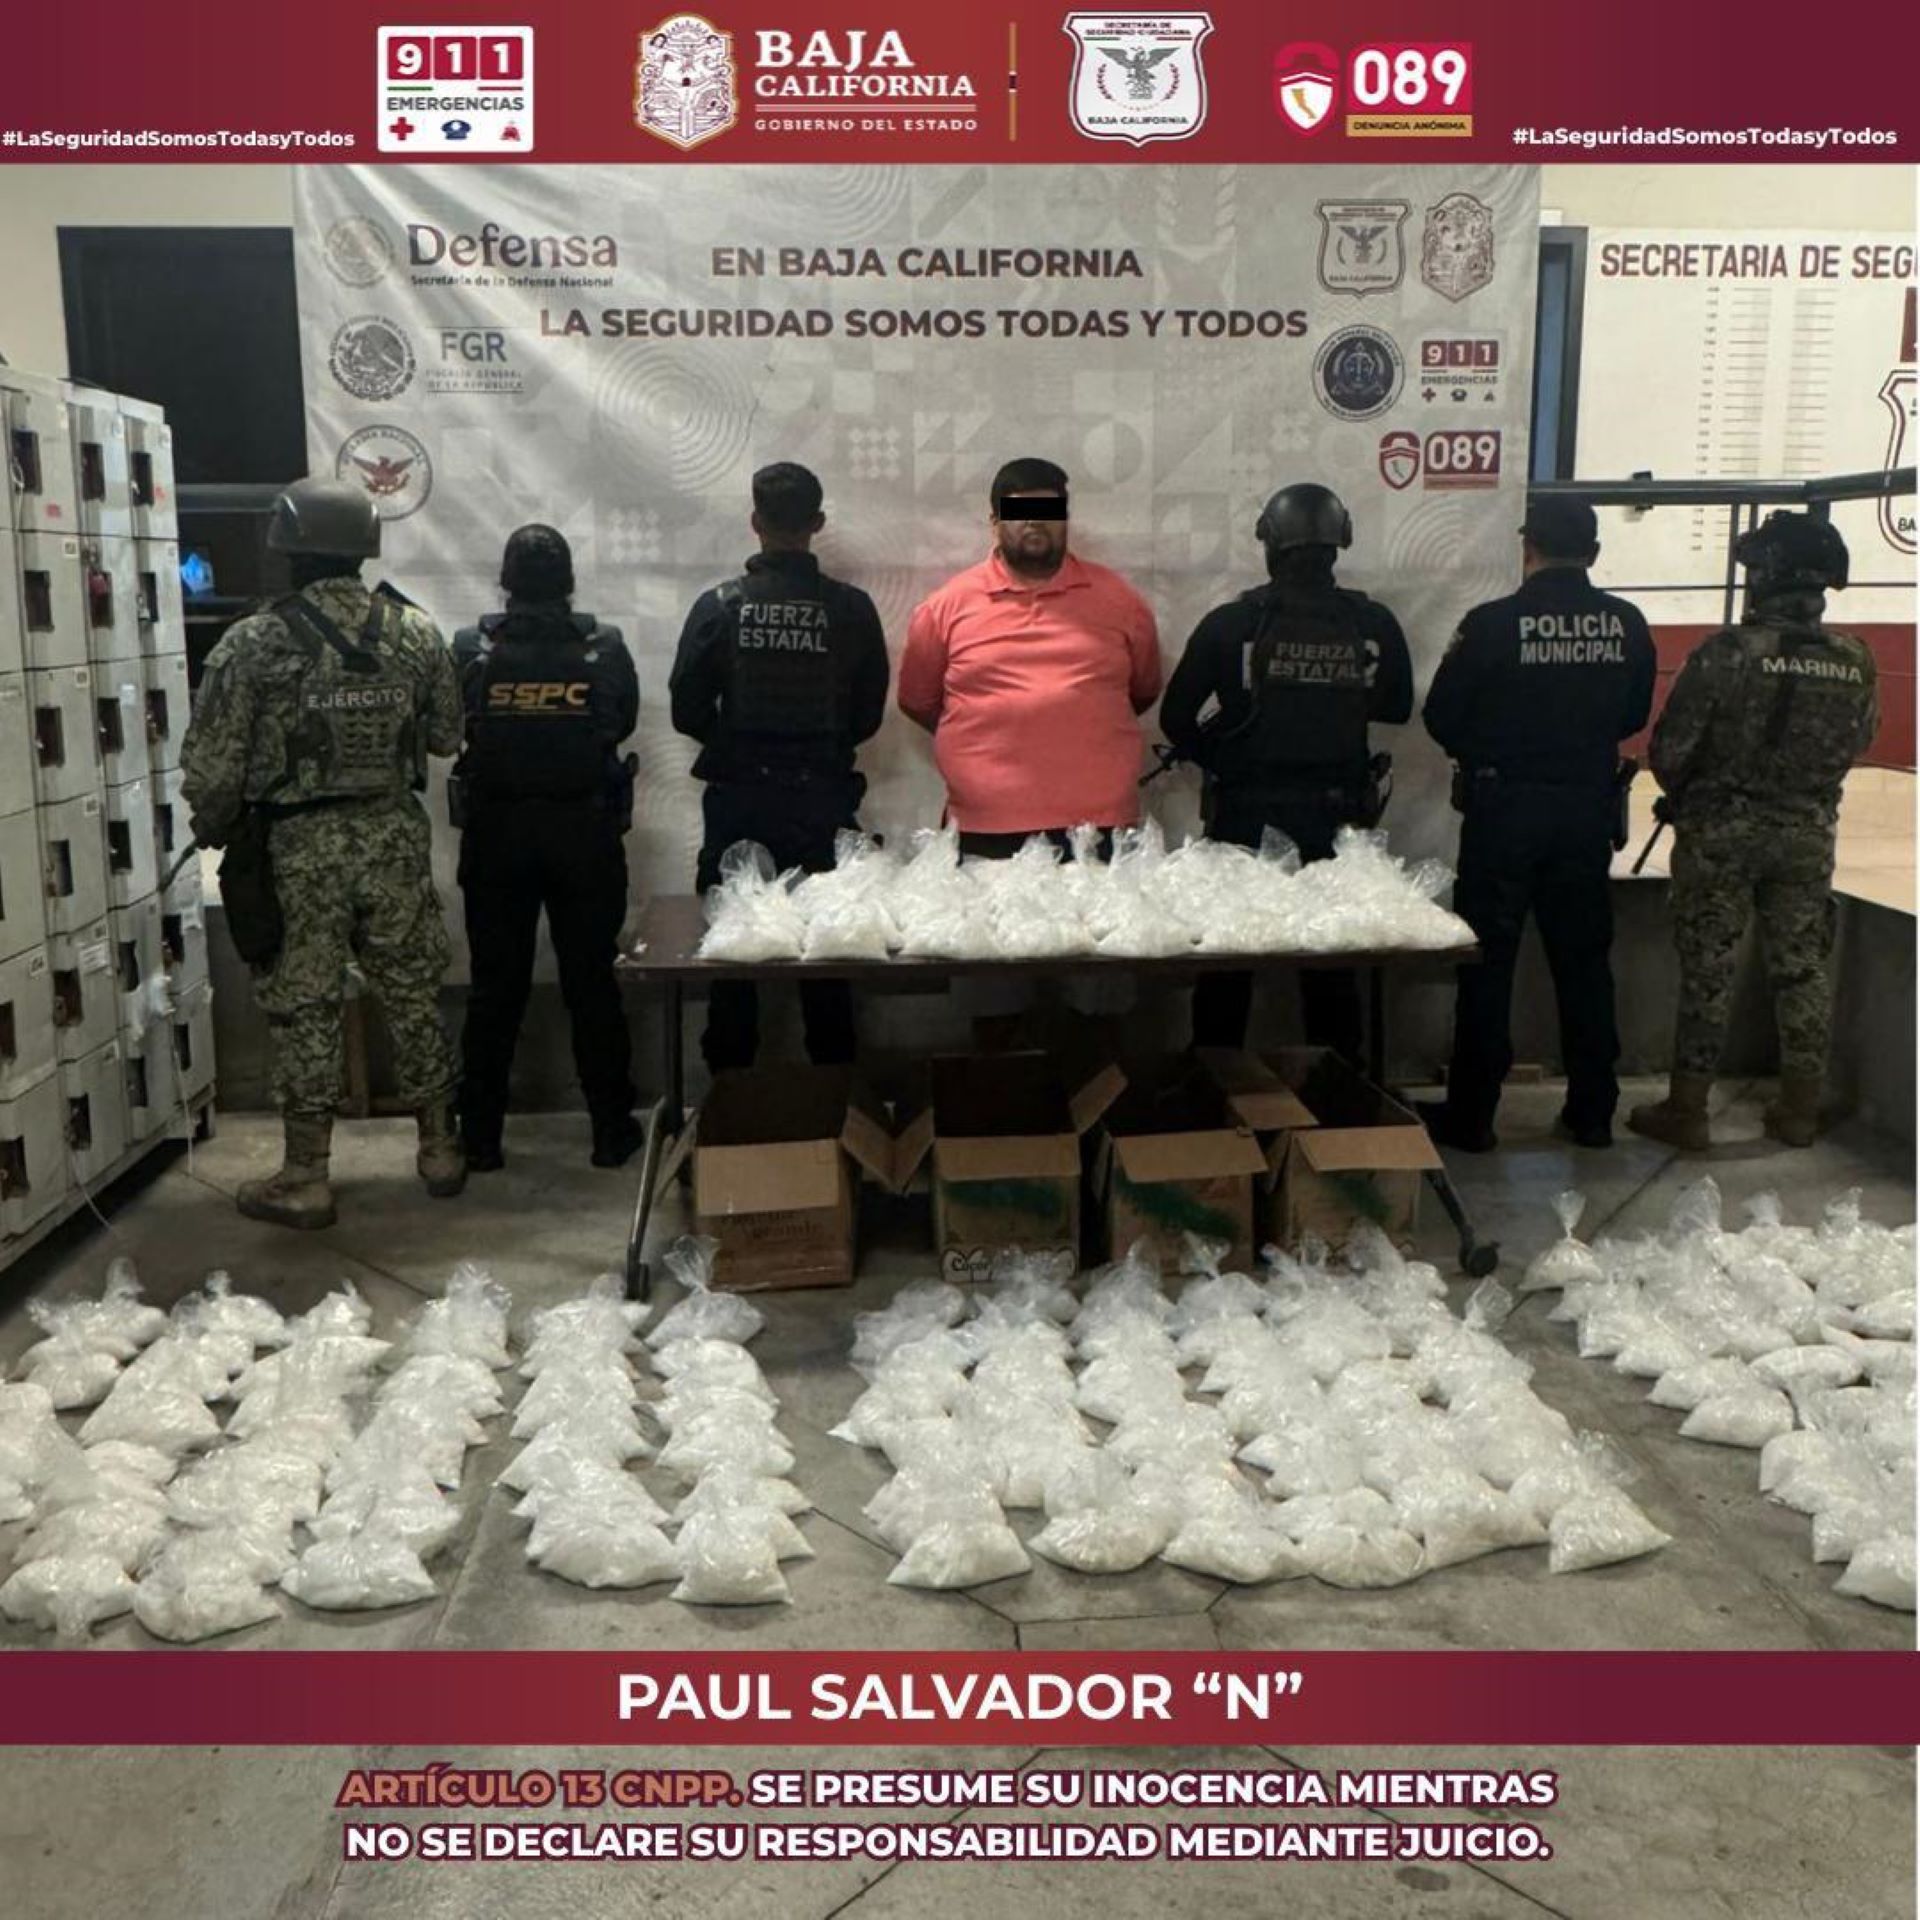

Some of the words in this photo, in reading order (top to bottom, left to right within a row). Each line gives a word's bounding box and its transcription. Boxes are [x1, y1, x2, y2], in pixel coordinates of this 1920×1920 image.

[407, 222, 617, 268] Defensa
[712, 248, 765, 275] EN
[779, 248, 886, 276] BAJA
[898, 249, 1143, 278] CALIFORNIA
[1600, 244, 1788, 278] SECRETARIA
[1800, 245, 1840, 278] DE
[540, 309, 590, 337] LA
[601, 309, 833, 338] SEGURIDAD
[845, 309, 986, 338] SOMOS
[997, 310, 1129, 338] TODAS
[1140, 311, 1165, 338] Y
[1175, 310, 1308, 338] TODOS
[441, 332, 507, 362] FGR
[1427, 345, 1492, 363] 911
[1421, 376, 1498, 384] EMERGENCIAS
[1428, 435, 1496, 470] 089
[739, 603, 829, 628] FUERZA
[1518, 610, 1625, 639] POLICÍA
[738, 629, 828, 652] ESTATAL
[1276, 642, 1357, 659] FUERZA
[1519, 639, 1625, 664] MUNICIPAL
[1268, 660, 1360, 679] ESTATAL
[1762, 656, 1863, 684] MARINA
[308, 687, 406, 709] EJÉRCITO
[488, 683, 589, 706] SSPC
